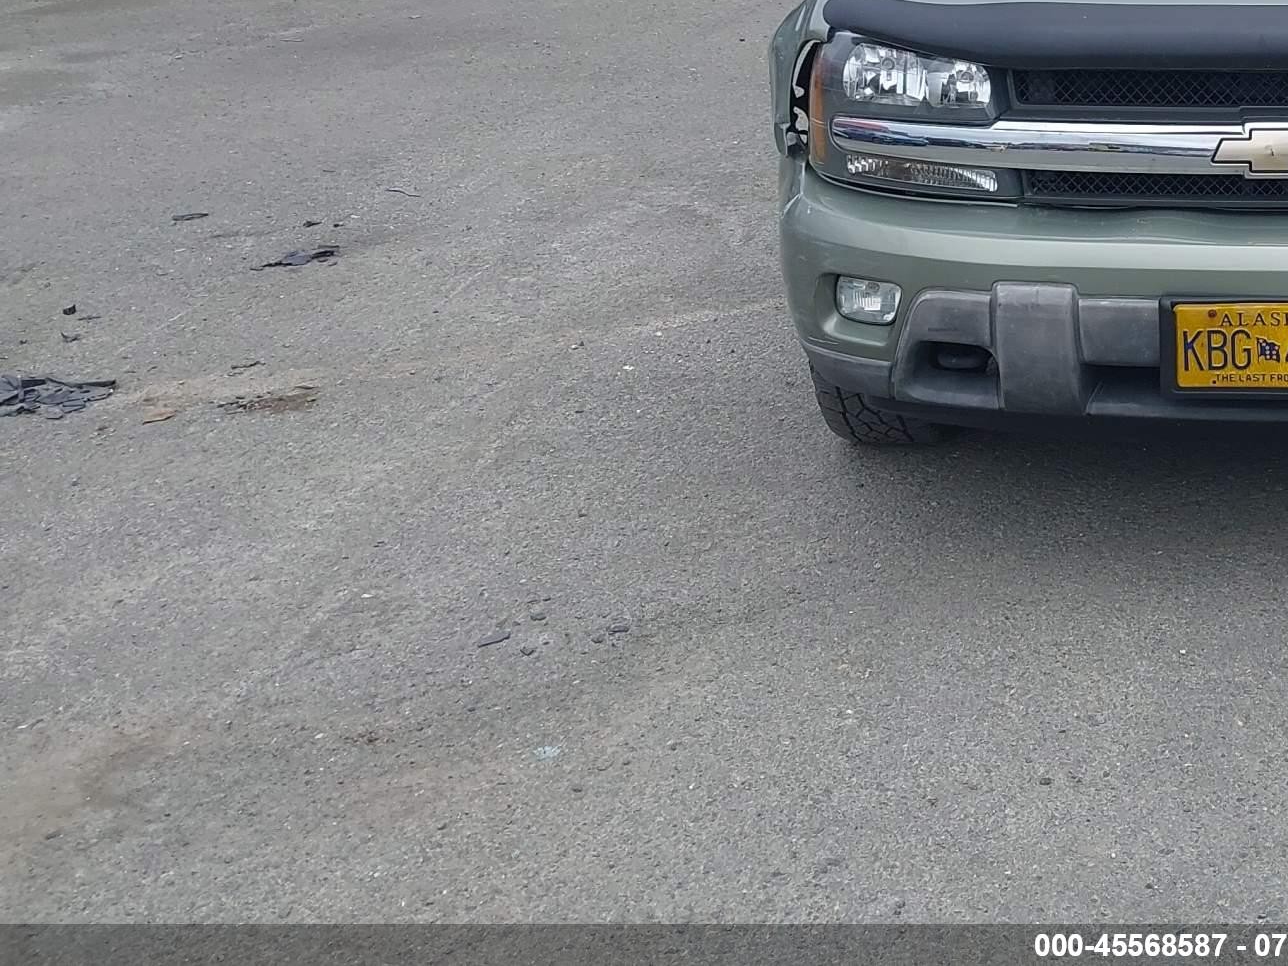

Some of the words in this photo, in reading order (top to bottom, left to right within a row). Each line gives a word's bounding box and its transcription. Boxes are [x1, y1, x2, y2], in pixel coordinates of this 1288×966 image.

[1182, 329, 1252, 371] KBG
[1215, 373, 1236, 383] THE
[1238, 373, 1266, 383] LAST
